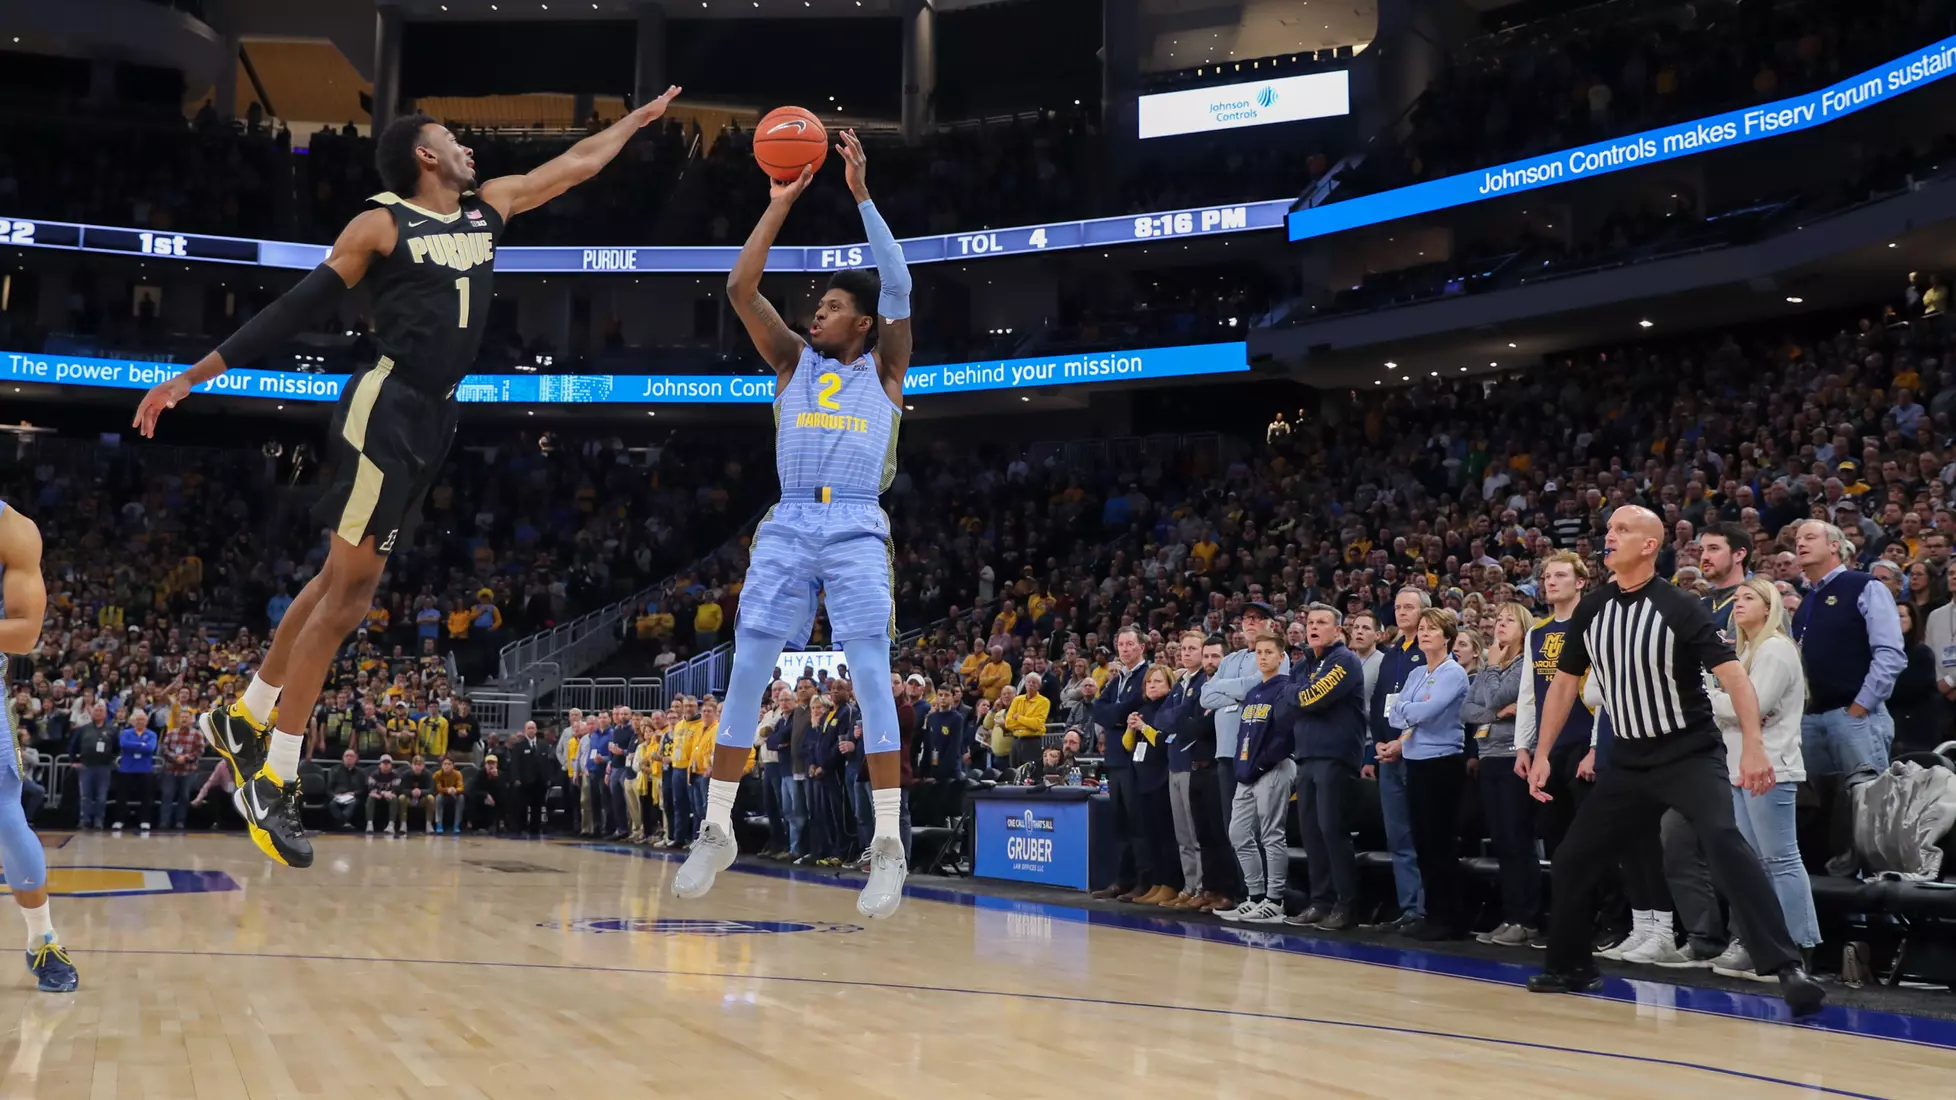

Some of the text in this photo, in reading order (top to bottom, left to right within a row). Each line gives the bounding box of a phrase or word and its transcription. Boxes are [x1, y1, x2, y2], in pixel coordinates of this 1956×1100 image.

[1209, 101, 1249, 113] Johnson
[1216, 109, 1257, 122] Controls
[1478, 160, 1563, 194] Johnson
[1568, 137, 1657, 174] Controls
[1662, 118, 1737, 154] makes
[1743, 102, 1815, 135] Fiserv
[1821, 77, 1883, 116] Forum
[1134, 207, 1247, 239] 8:16 PM
[139, 232, 187, 257] 1st
[407, 232, 494, 272] PURDUE
[957, 228, 1048, 255] TOL 4
[582, 249, 637, 270] PURDUE
[821, 247, 863, 268] FLS
[455, 276, 470, 328] 1
[8, 355, 338, 396] The power behi your mission
[903, 353, 1142, 389] wer behind your mission
[642, 377, 775, 397] Johnson Cont
[818, 372, 842, 411] 2
[796, 412, 869, 433] MARQUETTE
[1539, 631, 1566, 660] MU
[784, 654, 833, 666] HYATT
[1533, 660, 1558, 669] ARQUE
[1007, 836, 1053, 863] GRUBER
